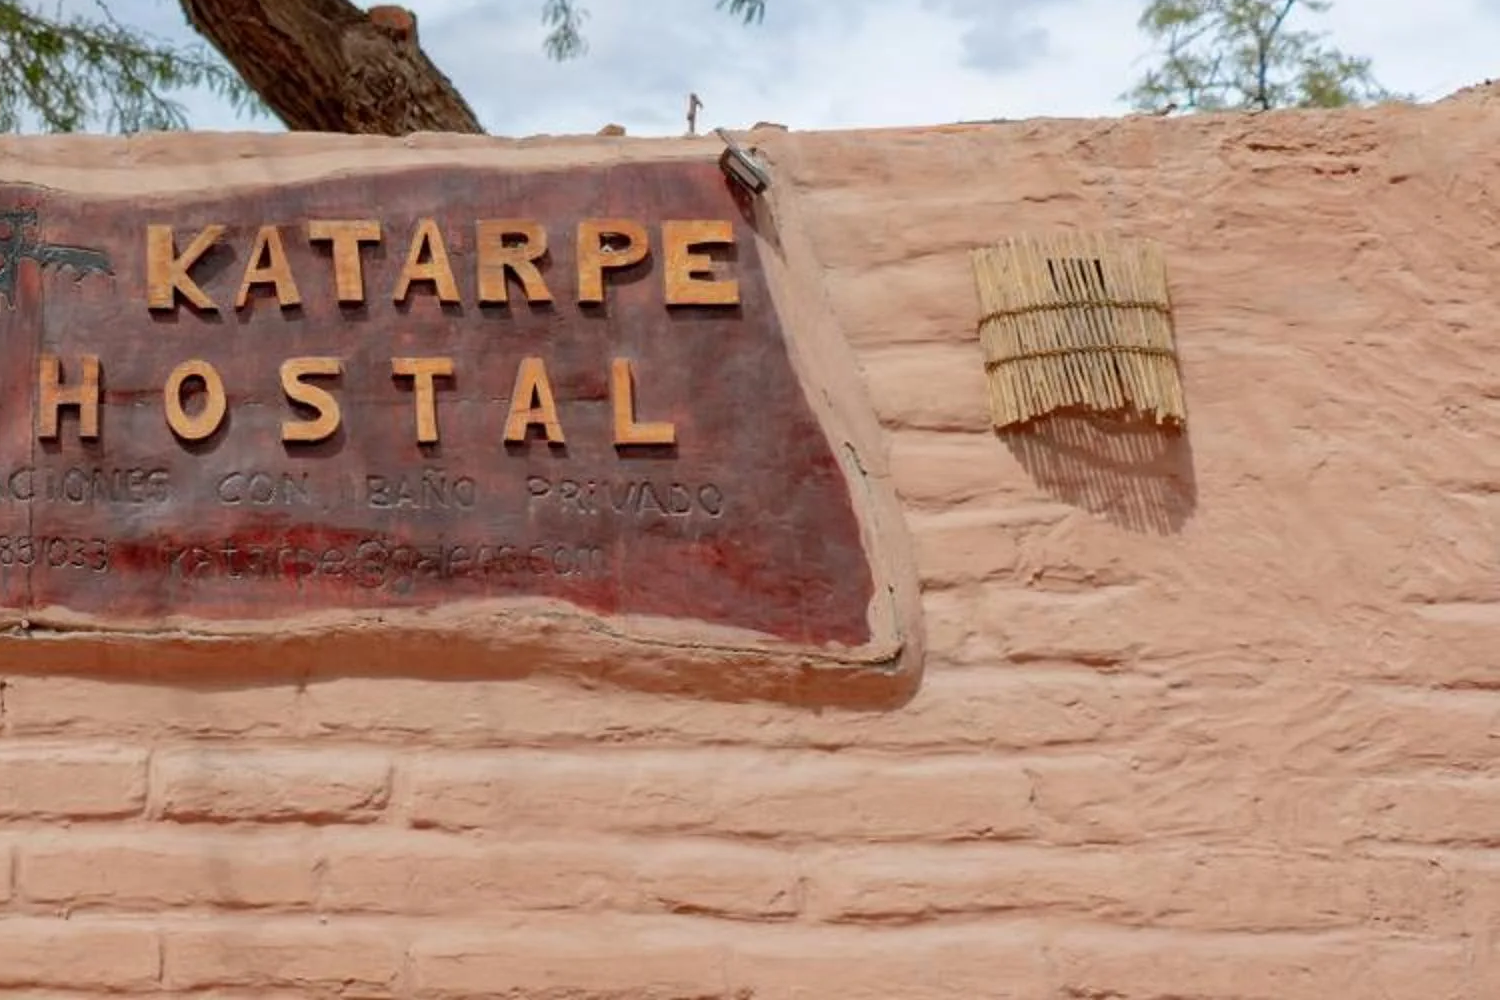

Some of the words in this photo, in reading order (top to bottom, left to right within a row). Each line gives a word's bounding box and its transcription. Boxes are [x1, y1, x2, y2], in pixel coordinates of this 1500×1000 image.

[146, 219, 740, 312] KATARPE
[38, 353, 676, 446] HOSTAL
[218, 471, 311, 505] CON
[365, 467, 477, 509] BAÑO
